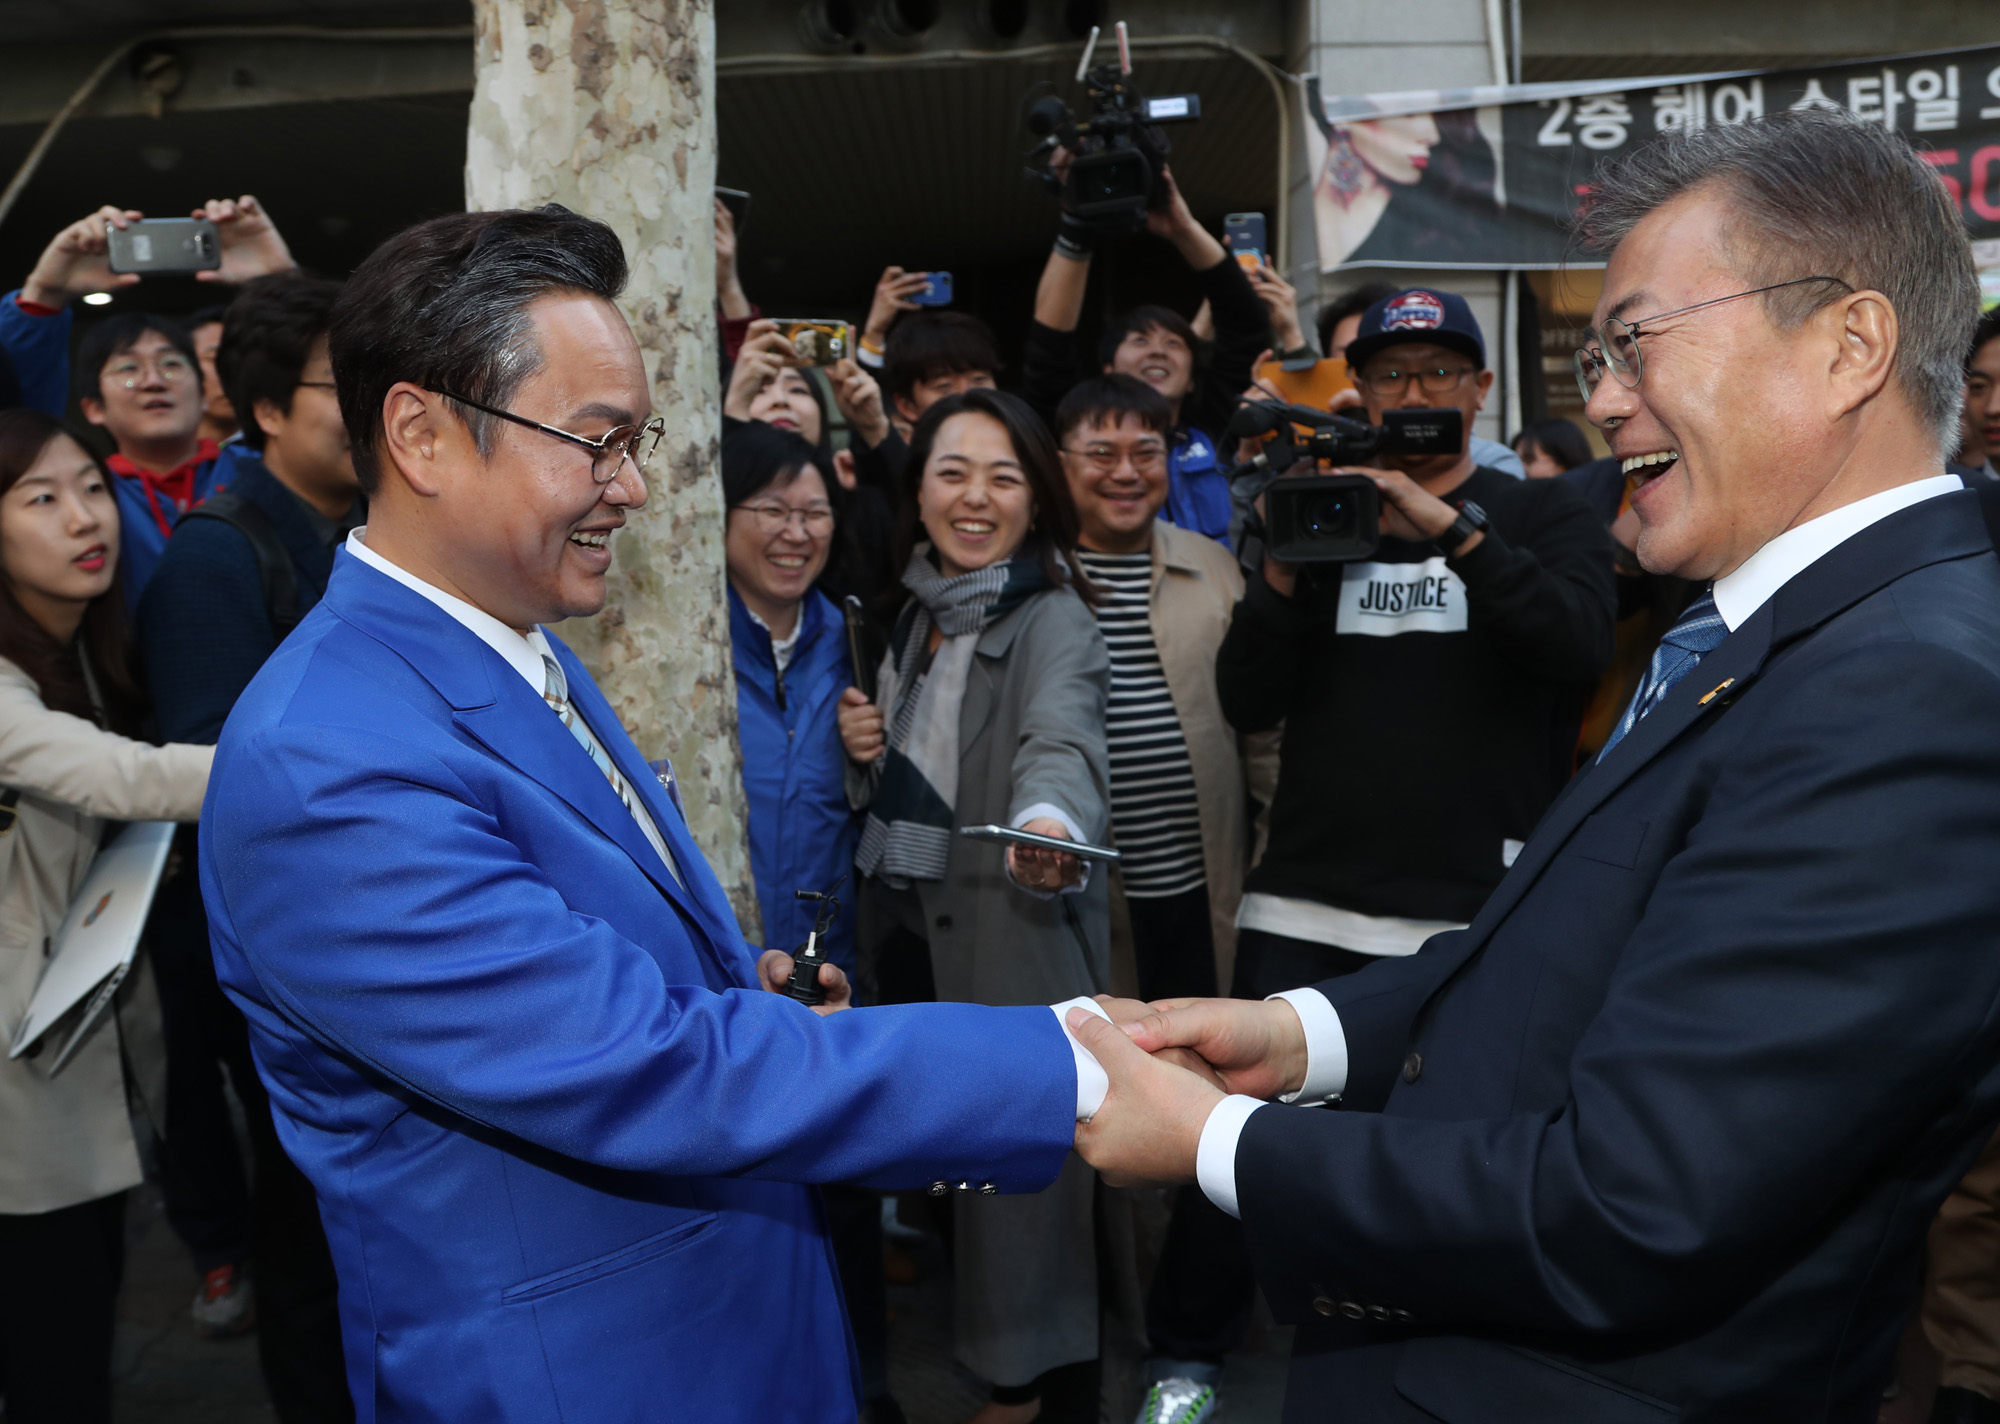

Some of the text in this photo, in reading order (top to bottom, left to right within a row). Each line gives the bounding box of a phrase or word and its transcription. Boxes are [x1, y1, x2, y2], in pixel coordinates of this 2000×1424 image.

[1537, 93, 1633, 149] 2층
[1653, 79, 1764, 140] 헤어
[1359, 576, 1448, 612] JUSTICE
